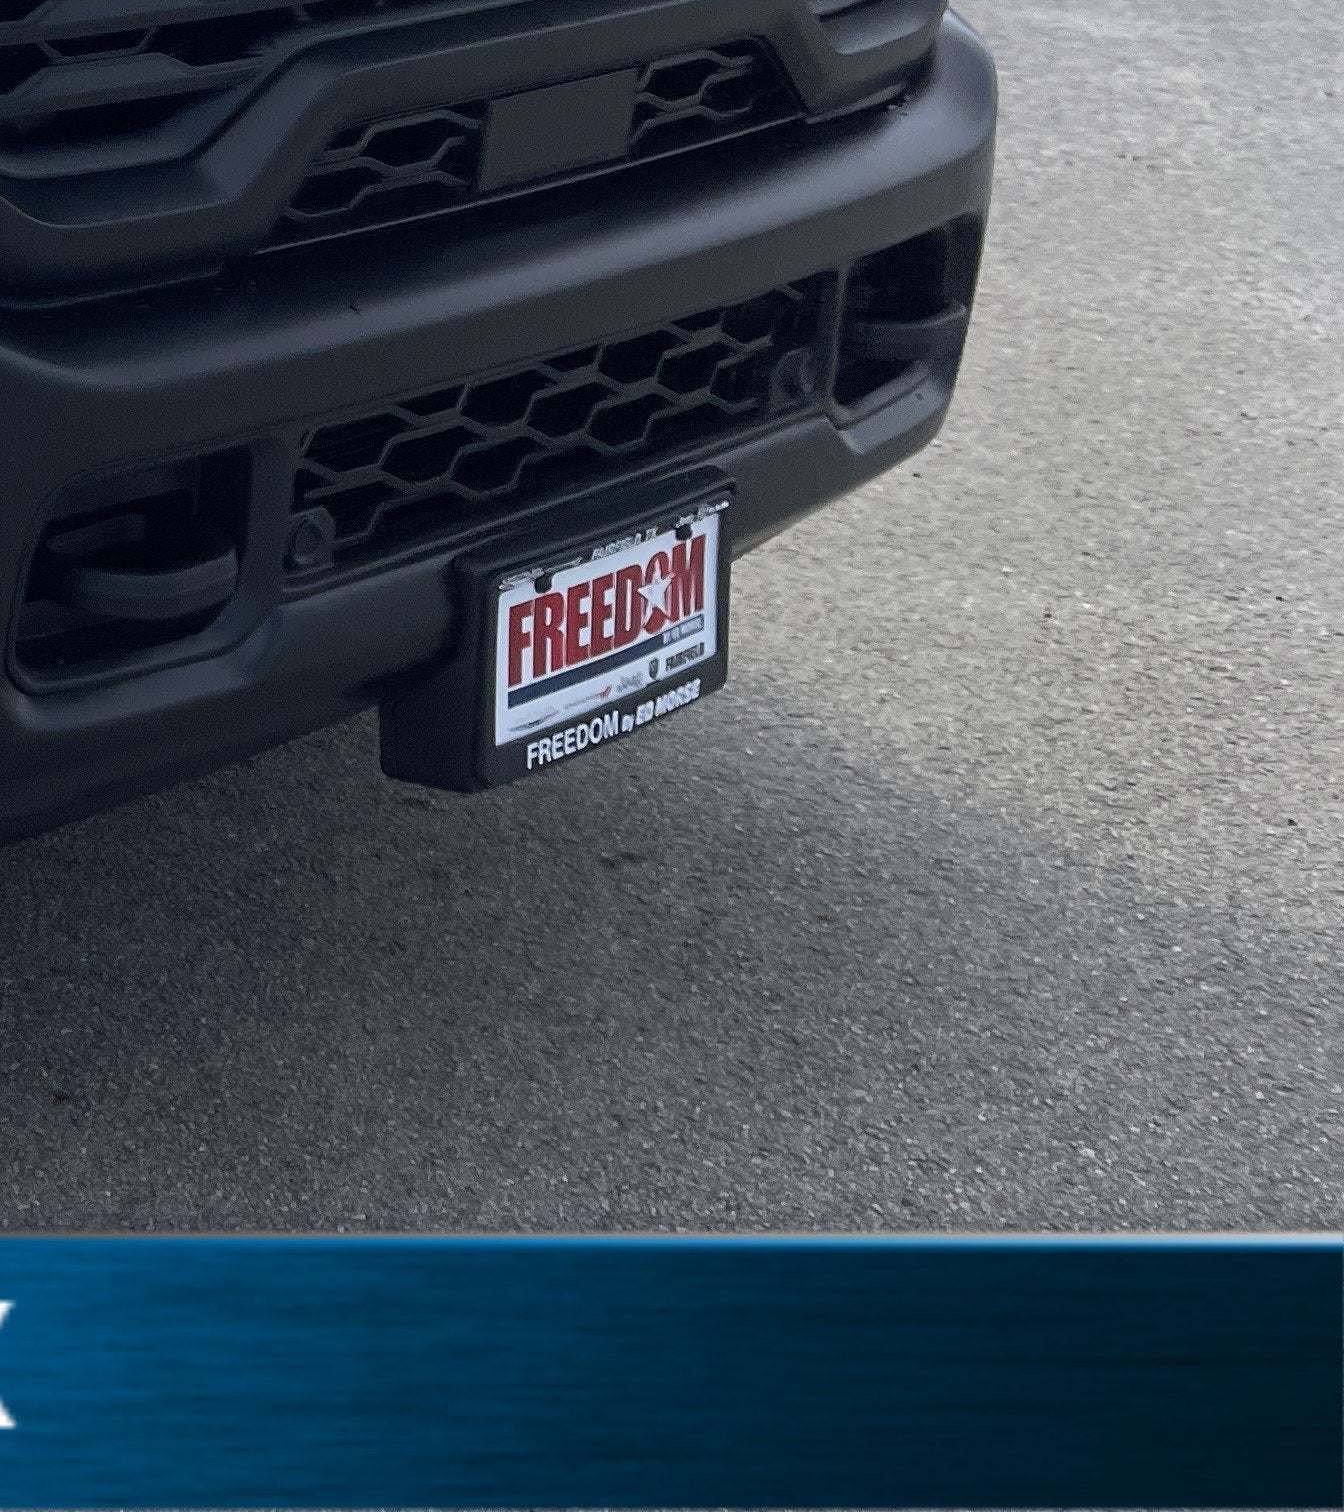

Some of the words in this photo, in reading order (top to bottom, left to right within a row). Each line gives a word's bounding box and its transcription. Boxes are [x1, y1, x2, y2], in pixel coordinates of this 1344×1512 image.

[507, 533, 707, 689] FREEDOM
[526, 710, 620, 770] FREEDOM
[635, 700, 655, 726] ED
[654, 678, 702, 717] MORSE
